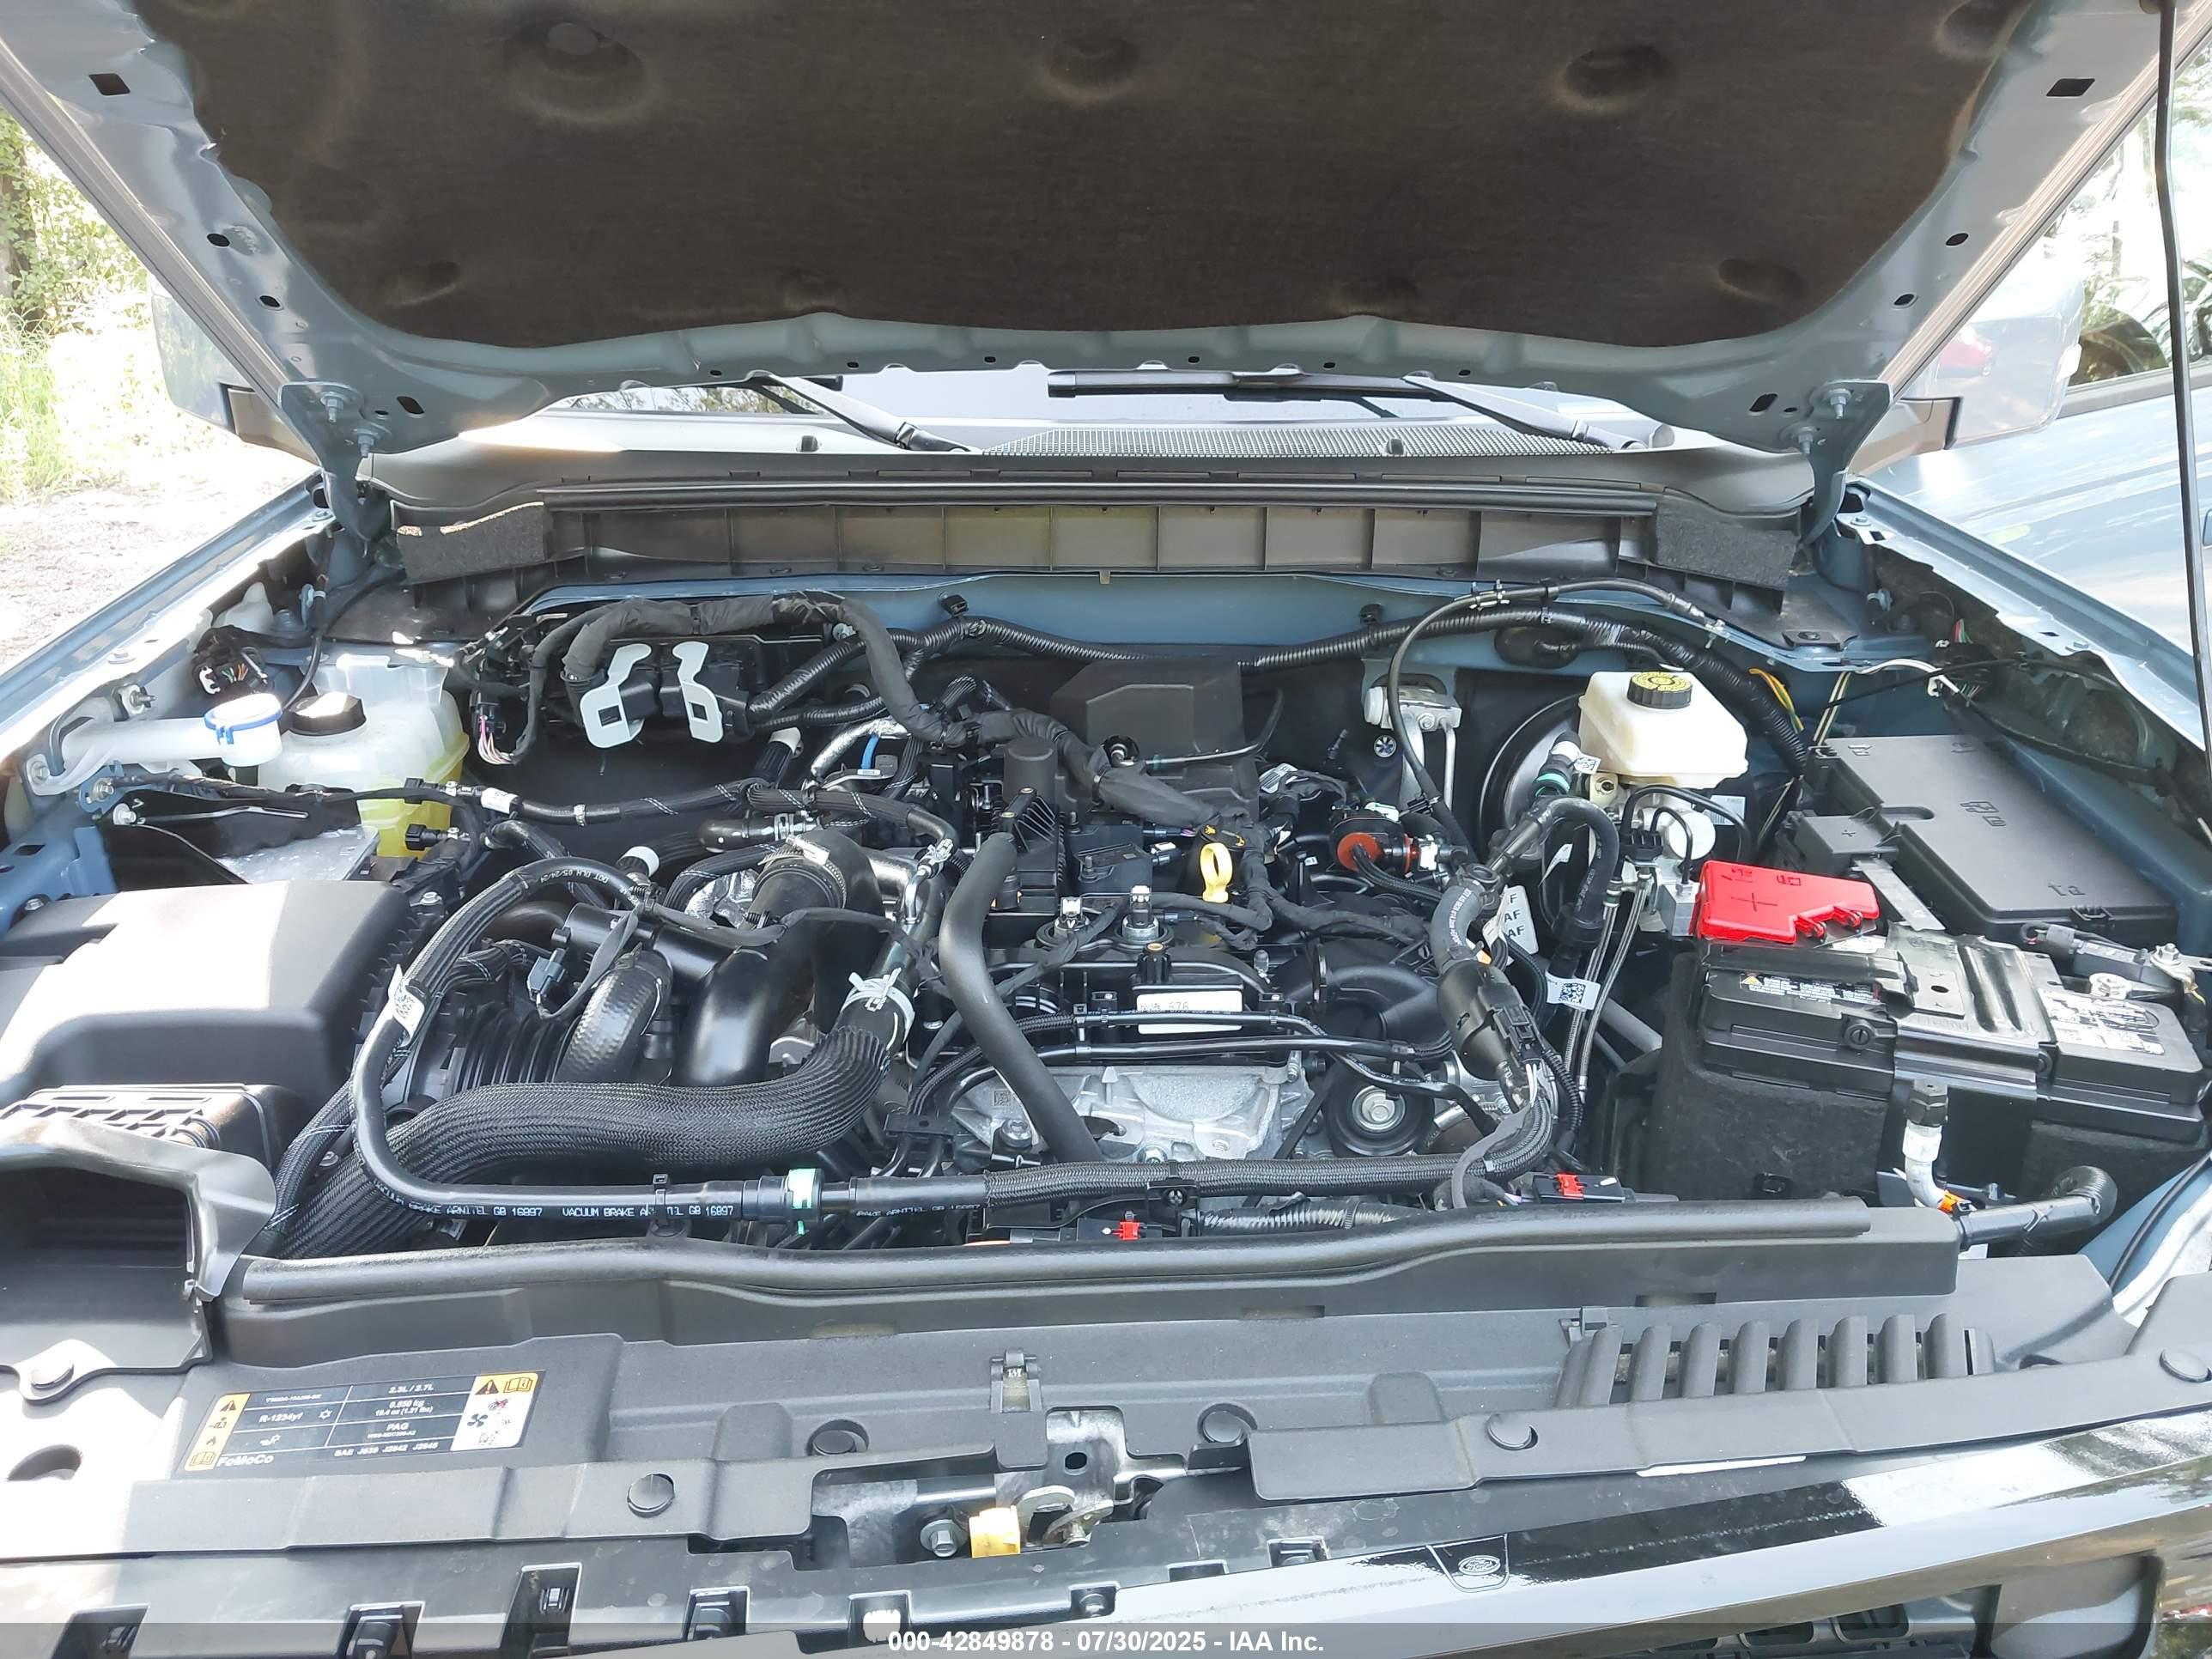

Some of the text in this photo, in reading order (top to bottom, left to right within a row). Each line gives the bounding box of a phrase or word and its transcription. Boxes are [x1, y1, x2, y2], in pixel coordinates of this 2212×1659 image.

[1503, 908, 1522, 923] AF
[493, 1206, 507, 1216] GB
[511, 1207, 543, 1217] 16897
[562, 1207, 599, 1217] VACUUM
[604, 1207, 635, 1217] BRAKE
[689, 1206, 702, 1215] GB
[705, 1206, 734, 1217] 16897
[216, 1454, 275, 1467] FoMoCo
